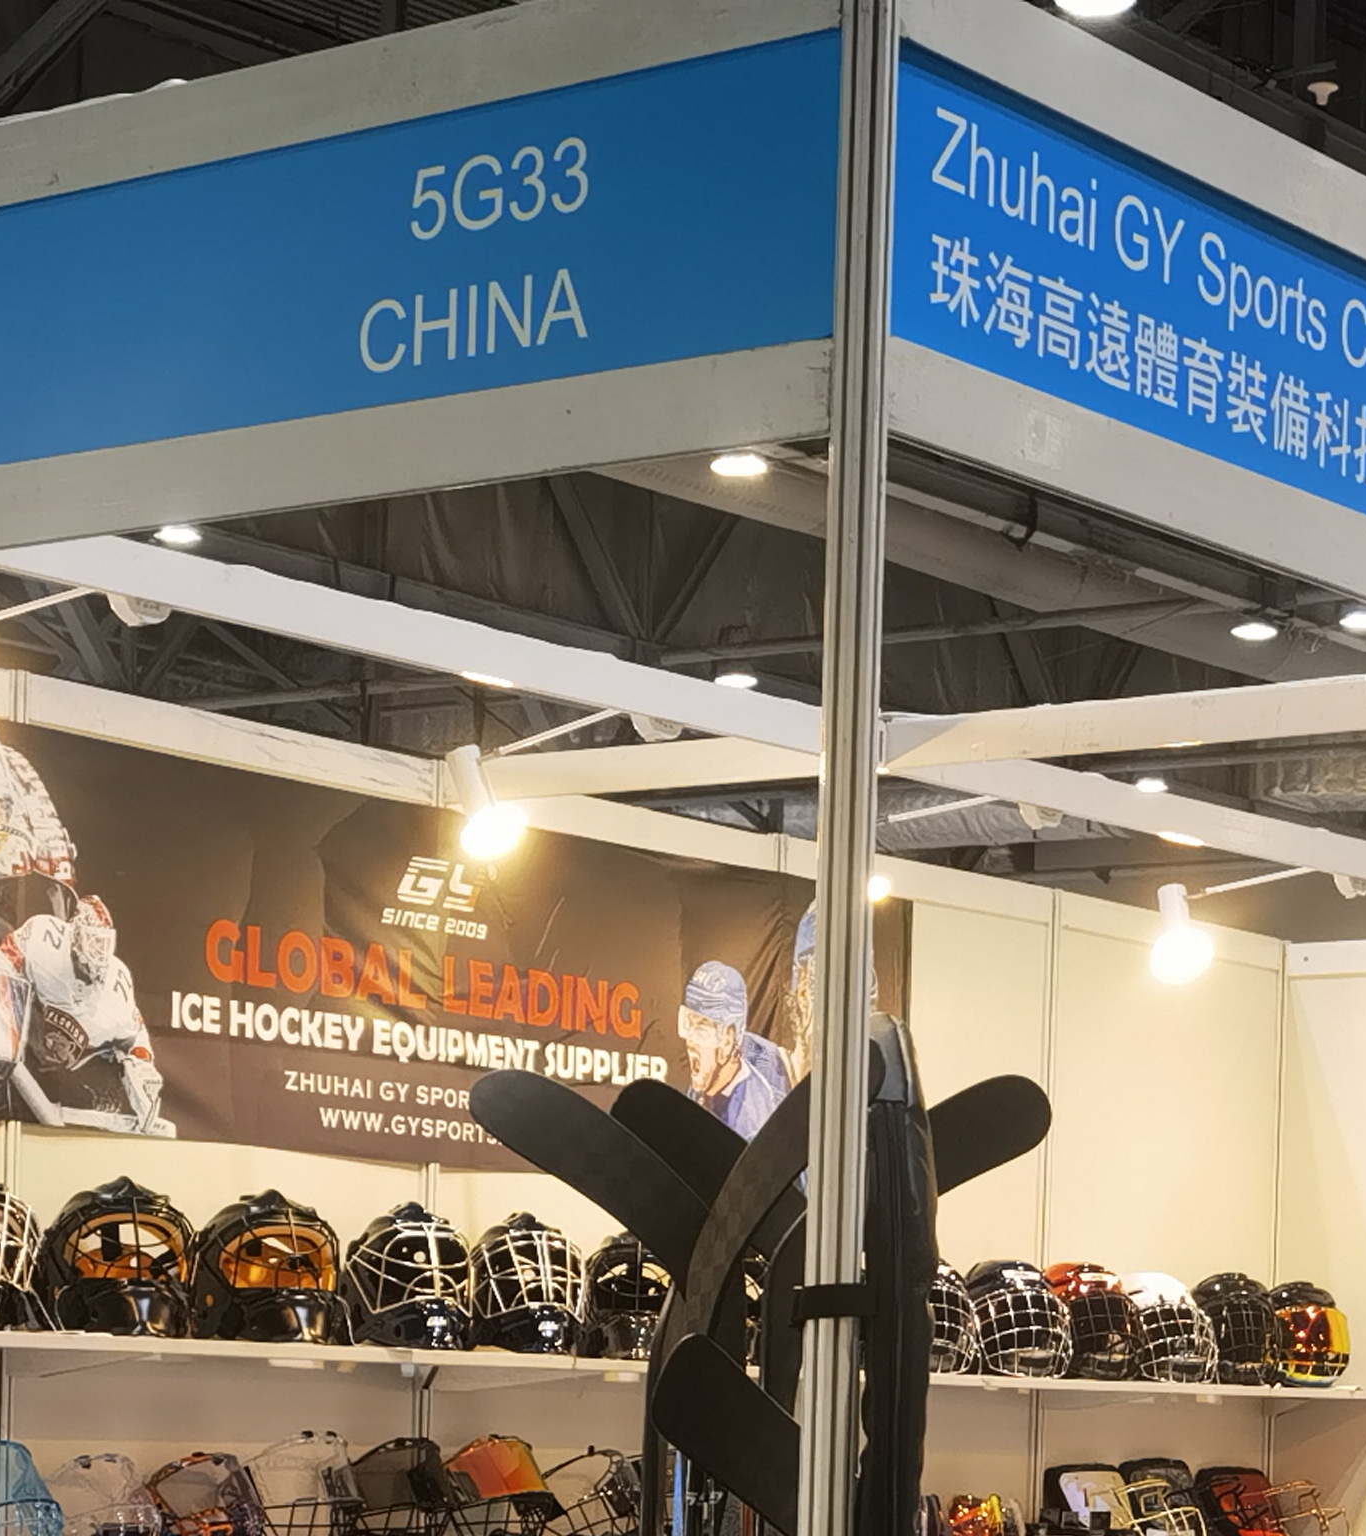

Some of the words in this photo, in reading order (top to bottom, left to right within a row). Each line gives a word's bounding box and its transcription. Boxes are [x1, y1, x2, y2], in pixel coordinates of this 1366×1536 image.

[410, 136, 590, 241] 5G33
[931, 106, 1098, 252] Zhuhai
[1114, 195, 1186, 284] GY
[1198, 231, 1327, 352] Sports
[359, 267, 589, 374] CHINA
[204, 917, 429, 1012] GLOBAL
[441, 954, 643, 1041] LEADING
[444, 917, 488, 941] 2009
[171, 990, 222, 1035] ICE
[229, 999, 366, 1055] HOCKEY
[372, 1017, 541, 1074] EQUIPMENT
[544, 1041, 669, 1087] SUPPLIER
[284, 1070, 373, 1099] ZHUHAI
[379, 1080, 410, 1103] GY
